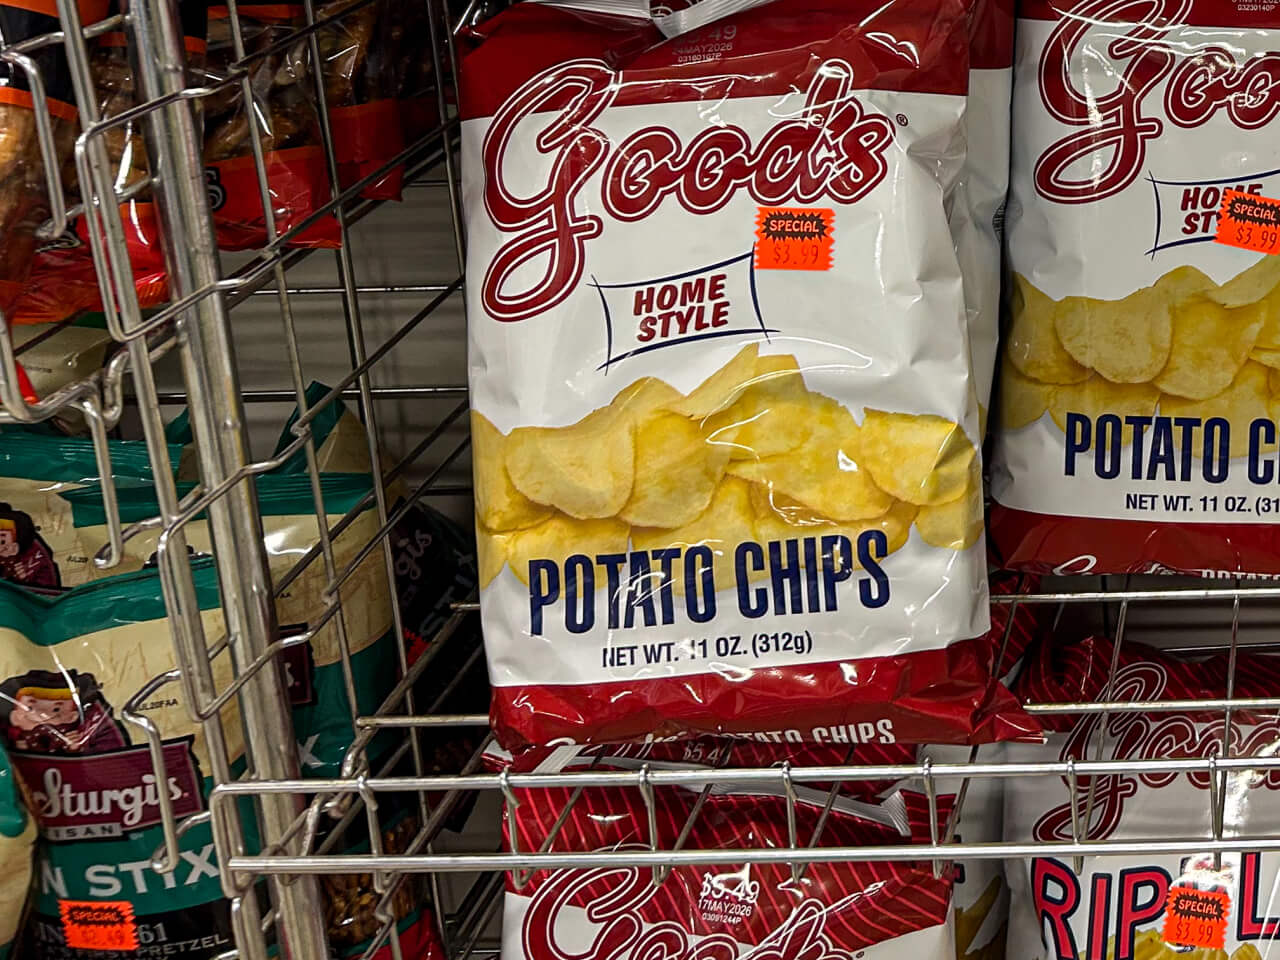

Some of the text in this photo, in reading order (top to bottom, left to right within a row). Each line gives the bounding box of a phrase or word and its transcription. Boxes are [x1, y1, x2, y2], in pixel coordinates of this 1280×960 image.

[1233, 201, 1277, 223] SPECIAL
[768, 216, 821, 235] SPECIAL
[1235, 225, 1278, 250] $3.99
[772, 242, 820, 268] $3.99
[633, 274, 726, 317] HOME
[637, 301, 731, 343] STYLE
[1063, 410, 1232, 484] POTATO
[1125, 492, 1158, 512] NET
[1162, 494, 1194, 513] WT.
[1199, 495, 1219, 513] 11
[1224, 495, 1251, 514] OZ.
[528, 544, 718, 638] POTATO
[734, 529, 891, 618] CHIPS
[602, 646, 639, 669] NET
[643, 643, 680, 666] WT.
[716, 636, 748, 659] OZ.
[751, 630, 813, 659] (312g)
[701, 871, 760, 903] $5.49
[697, 898, 752, 917] 17MAY2026
[1177, 898, 1219, 916] SPECIAL
[1175, 922, 1214, 944] $3.99
